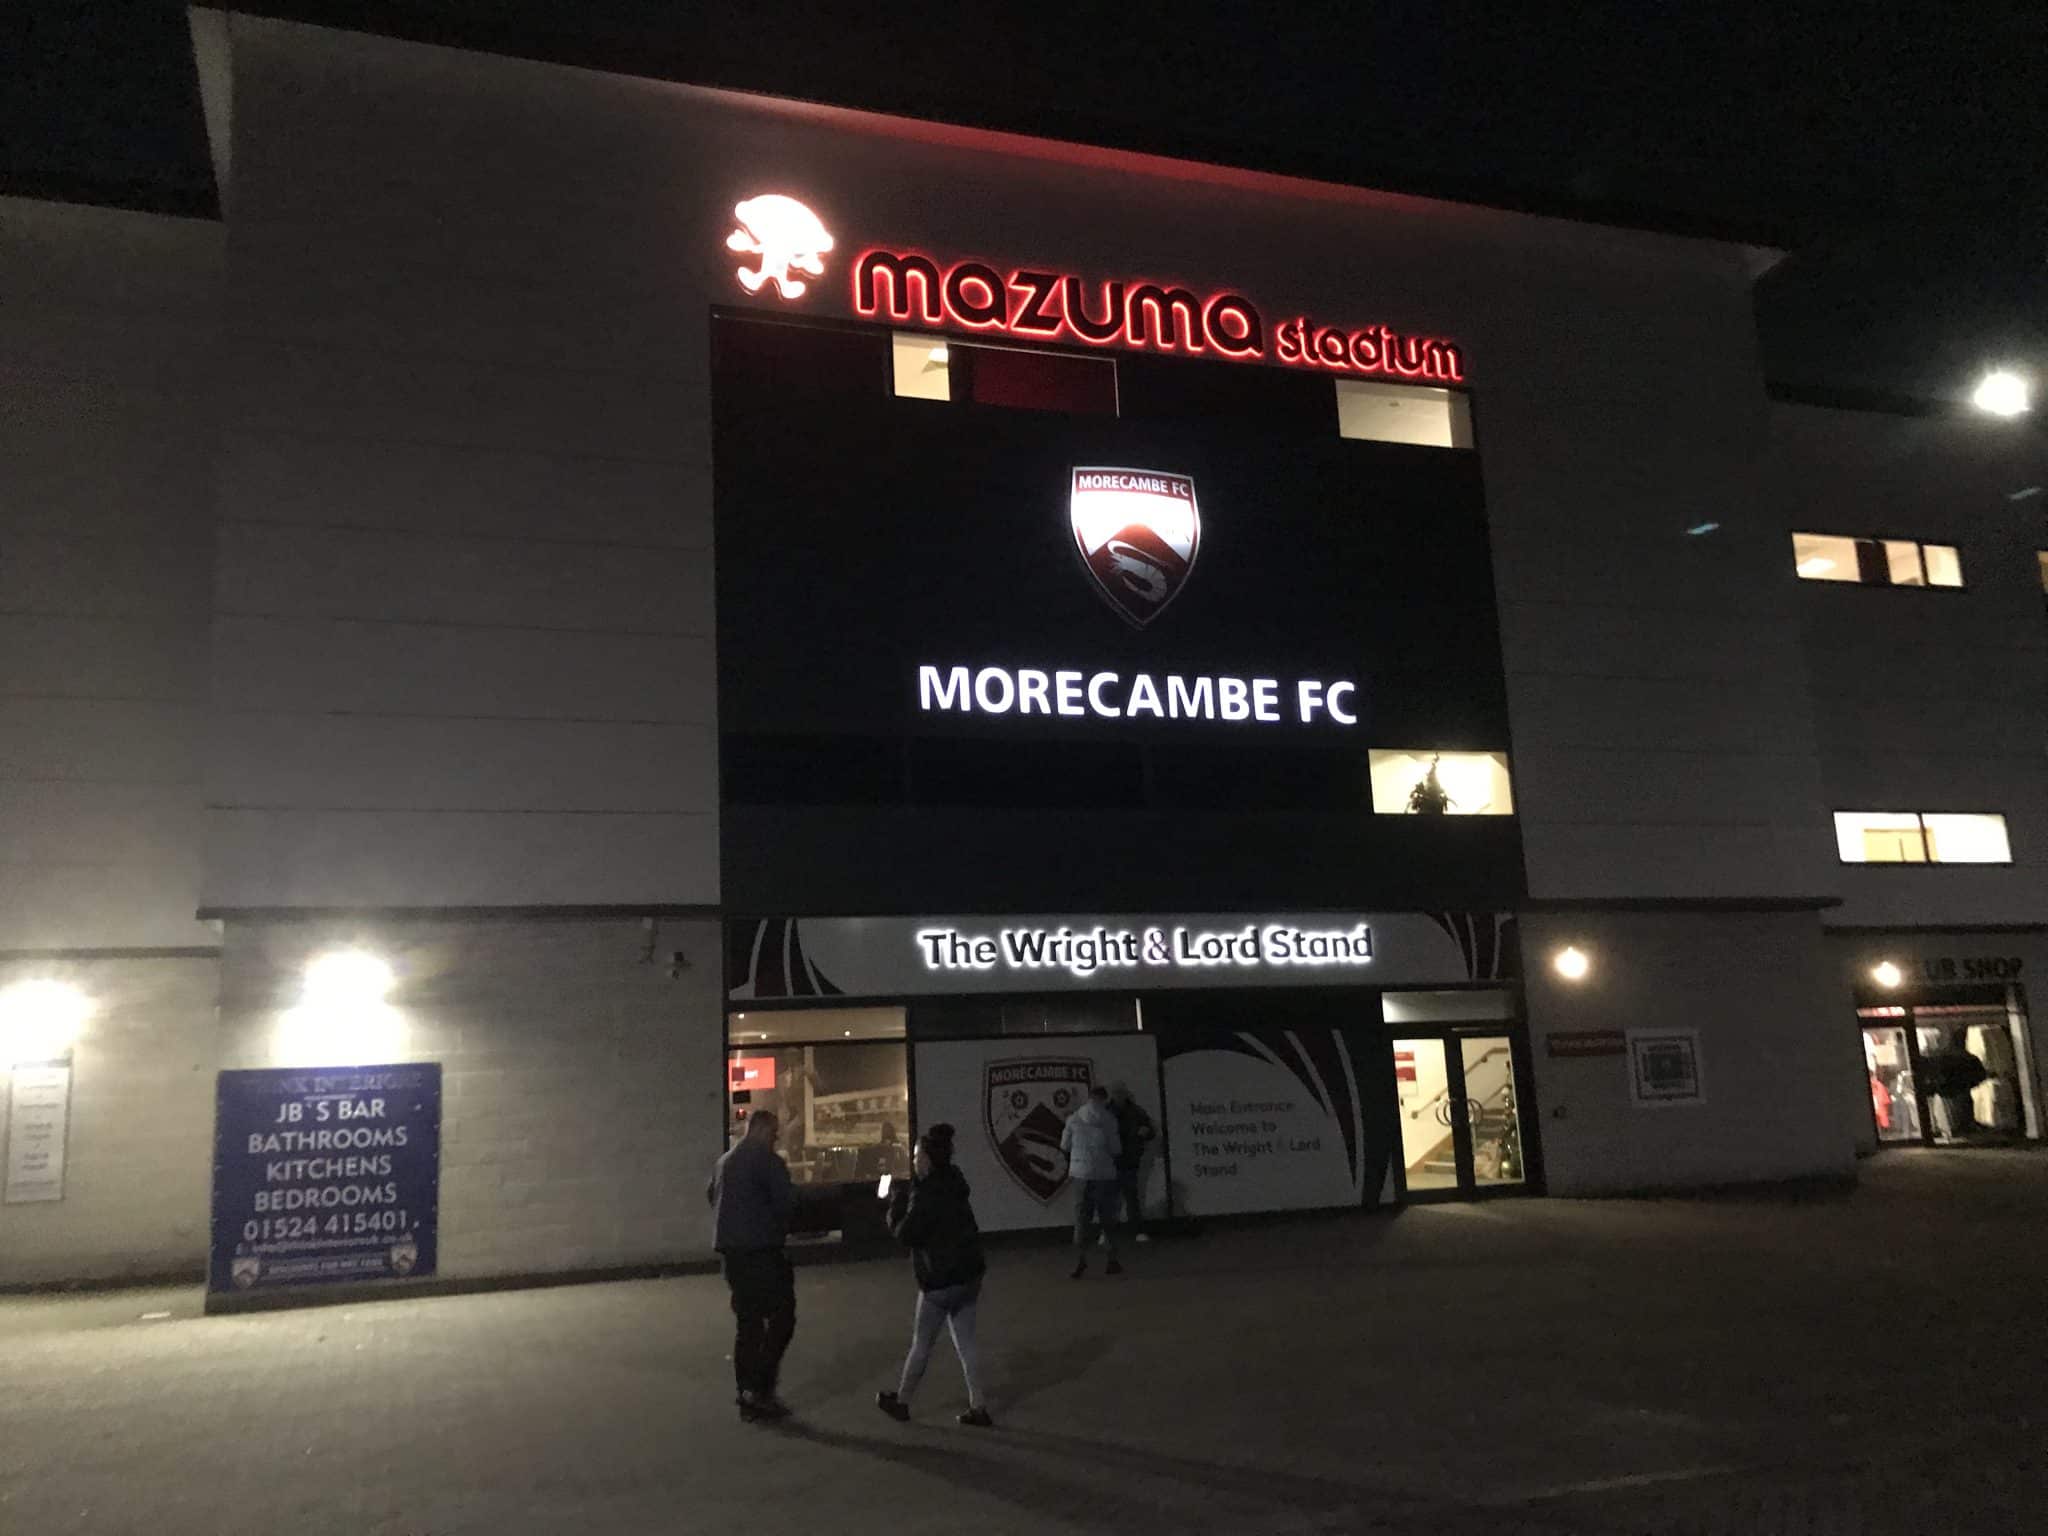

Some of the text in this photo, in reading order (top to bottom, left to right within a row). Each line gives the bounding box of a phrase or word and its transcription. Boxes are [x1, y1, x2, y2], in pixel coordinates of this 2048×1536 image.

[854, 250, 1463, 381] mazuma stadium
[1079, 475, 1190, 497] MORECAMBE FC
[919, 665, 1358, 724] MORECAMBE FC
[920, 926, 1374, 972] The Wright & Lord Stand
[338, 1098, 386, 1120] BAR
[247, 1125, 409, 1154] BATHROOMS
[1262, 1119, 1278, 1133] to
[1192, 1142, 1219, 1157] The
[266, 1154, 392, 1183] KITCHENS
[253, 1182, 398, 1213] BEDROOMS
[243, 1210, 407, 1241] 01524 415401
